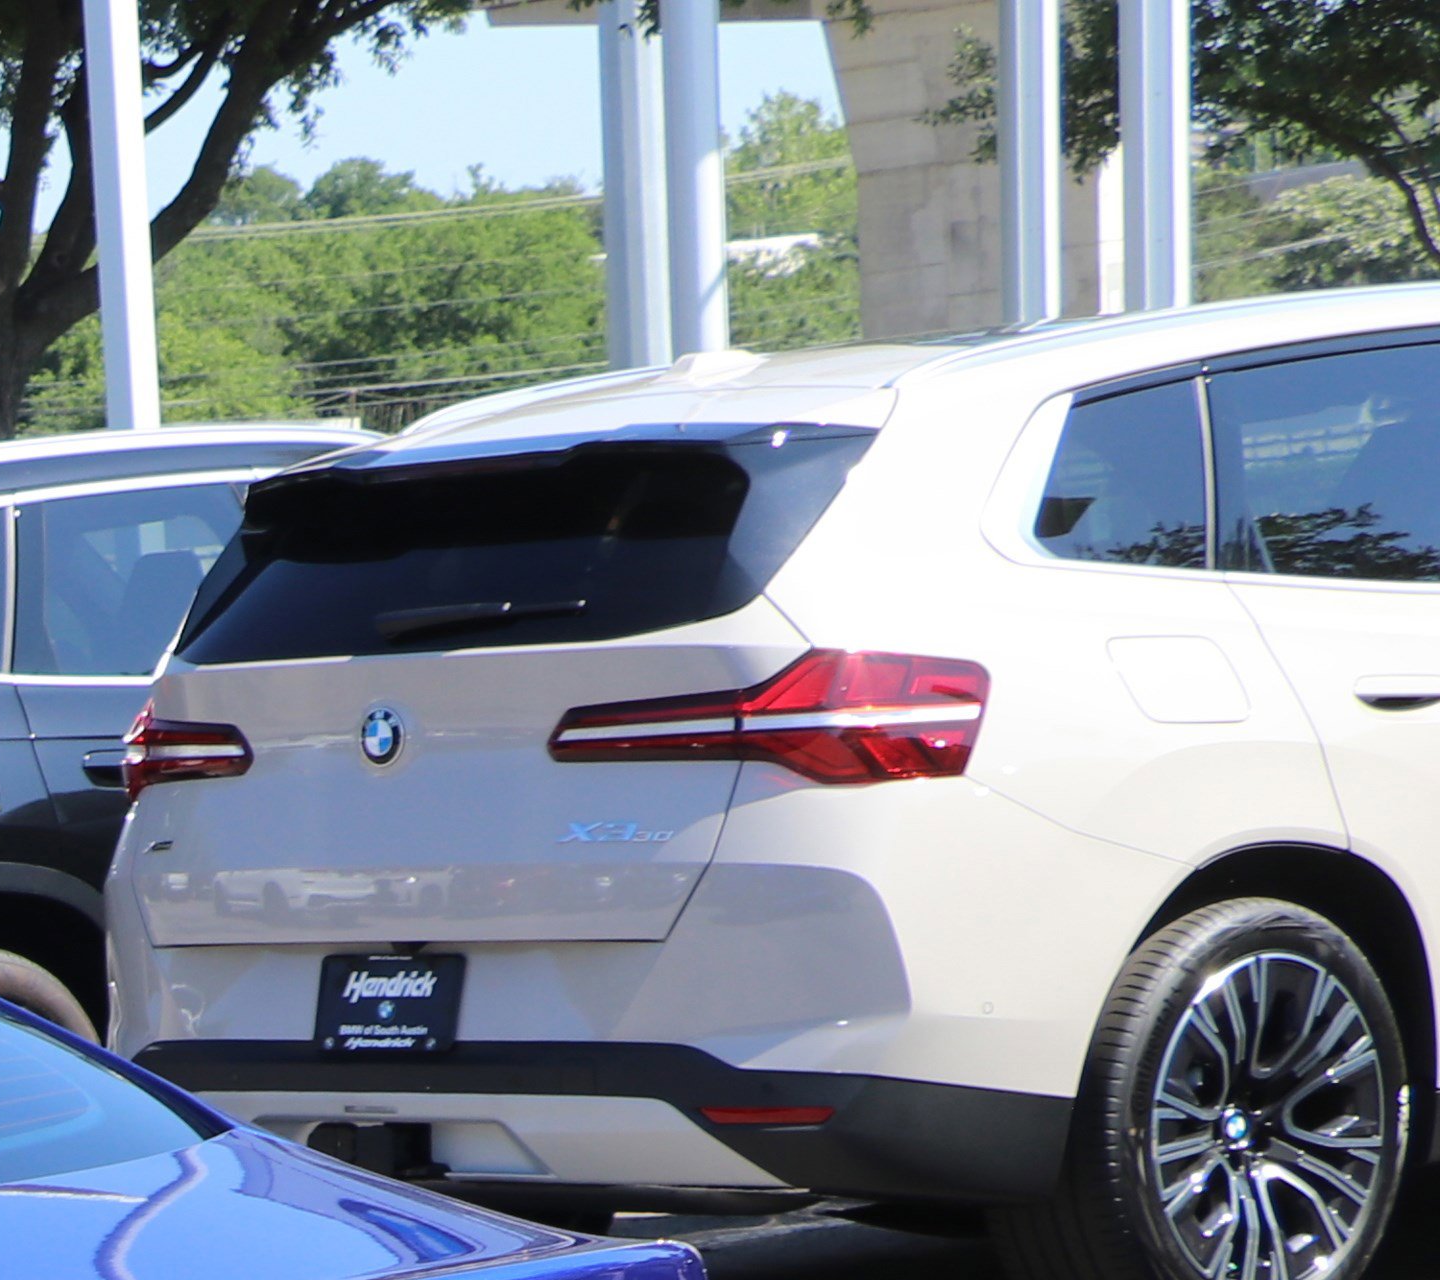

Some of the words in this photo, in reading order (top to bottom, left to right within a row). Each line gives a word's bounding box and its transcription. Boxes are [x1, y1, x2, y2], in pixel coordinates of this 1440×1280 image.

[342, 970, 438, 1003] Hendrick
[338, 1024, 363, 1036] BMW
[363, 1025, 373, 1035] of
[373, 1025, 399, 1035] South
[400, 1025, 428, 1035] Austin
[343, 1037, 417, 1049] Hendrick
